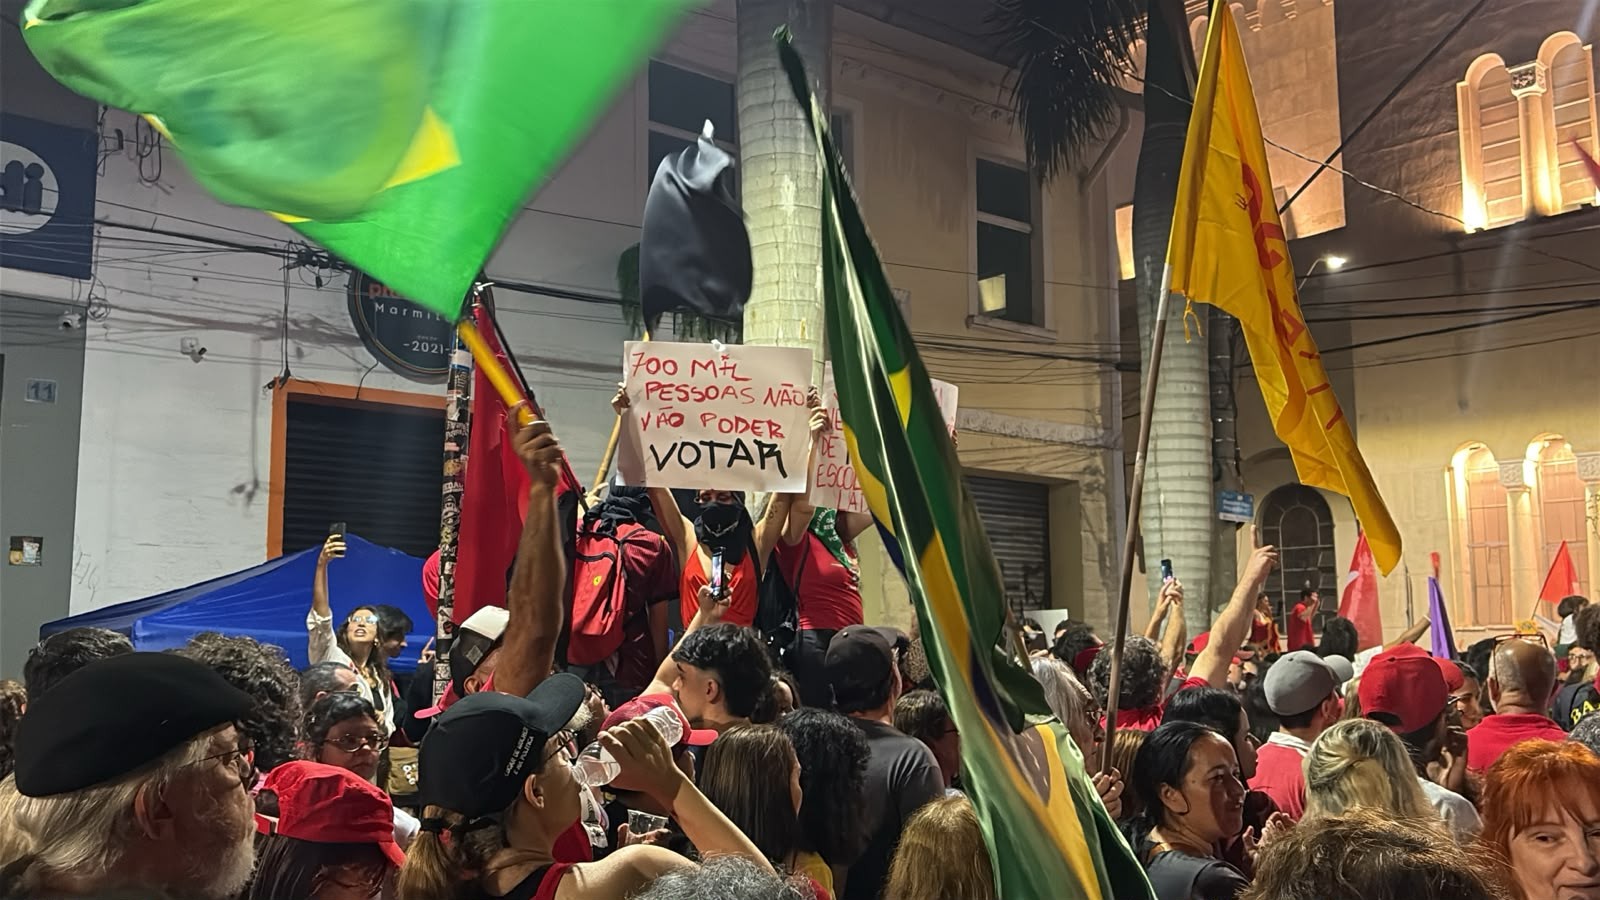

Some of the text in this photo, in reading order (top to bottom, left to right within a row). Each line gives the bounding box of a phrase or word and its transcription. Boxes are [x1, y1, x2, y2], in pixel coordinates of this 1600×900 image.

[374, 302, 447, 322] Marmit
[632, 352, 678, 377] 700
[31, 382, 53, 400] 11
[645, 381, 805, 407] PESSOAS NÃO
[641, 406, 785, 440] VÃO PODER
[649, 438, 788, 479] VOTAR
[821, 436, 840, 458] DE
[816, 463, 863, 491] ESCOL
[1570, 700, 1600, 725] BA
